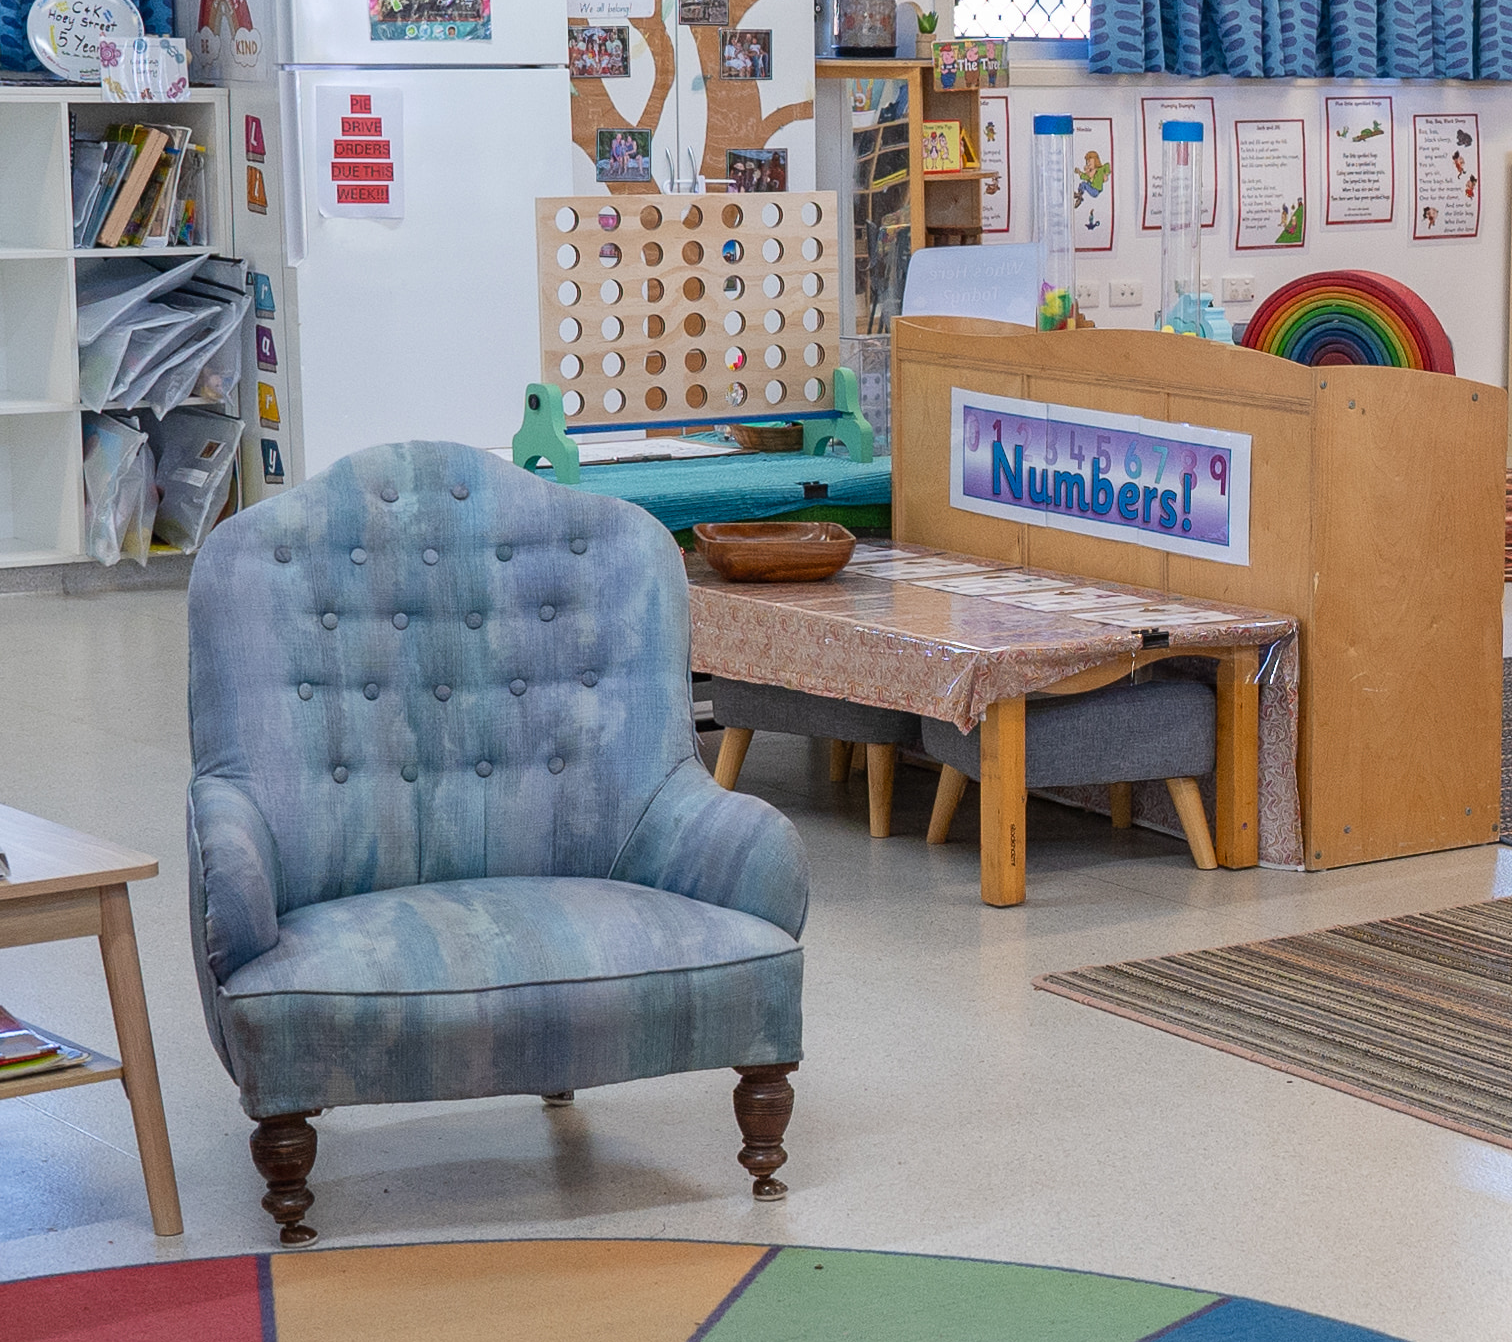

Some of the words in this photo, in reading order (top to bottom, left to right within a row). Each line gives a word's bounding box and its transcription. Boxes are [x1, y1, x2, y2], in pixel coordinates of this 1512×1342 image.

[580, 3, 593, 13] We
[48, 9, 75, 32] Hoey
[80, 17, 118, 32] Street
[235, 40, 258, 55] KIND
[957, 58, 978, 72] The
[351, 97, 371, 110] PIE
[342, 121, 382, 133] DRIVE
[334, 143, 390, 156] ORDERS
[332, 165, 360, 178] DUE
[364, 165, 393, 178] THIS
[338, 188, 389, 201] WEEK!!!
[992, 440, 1193, 533] Numbers!
